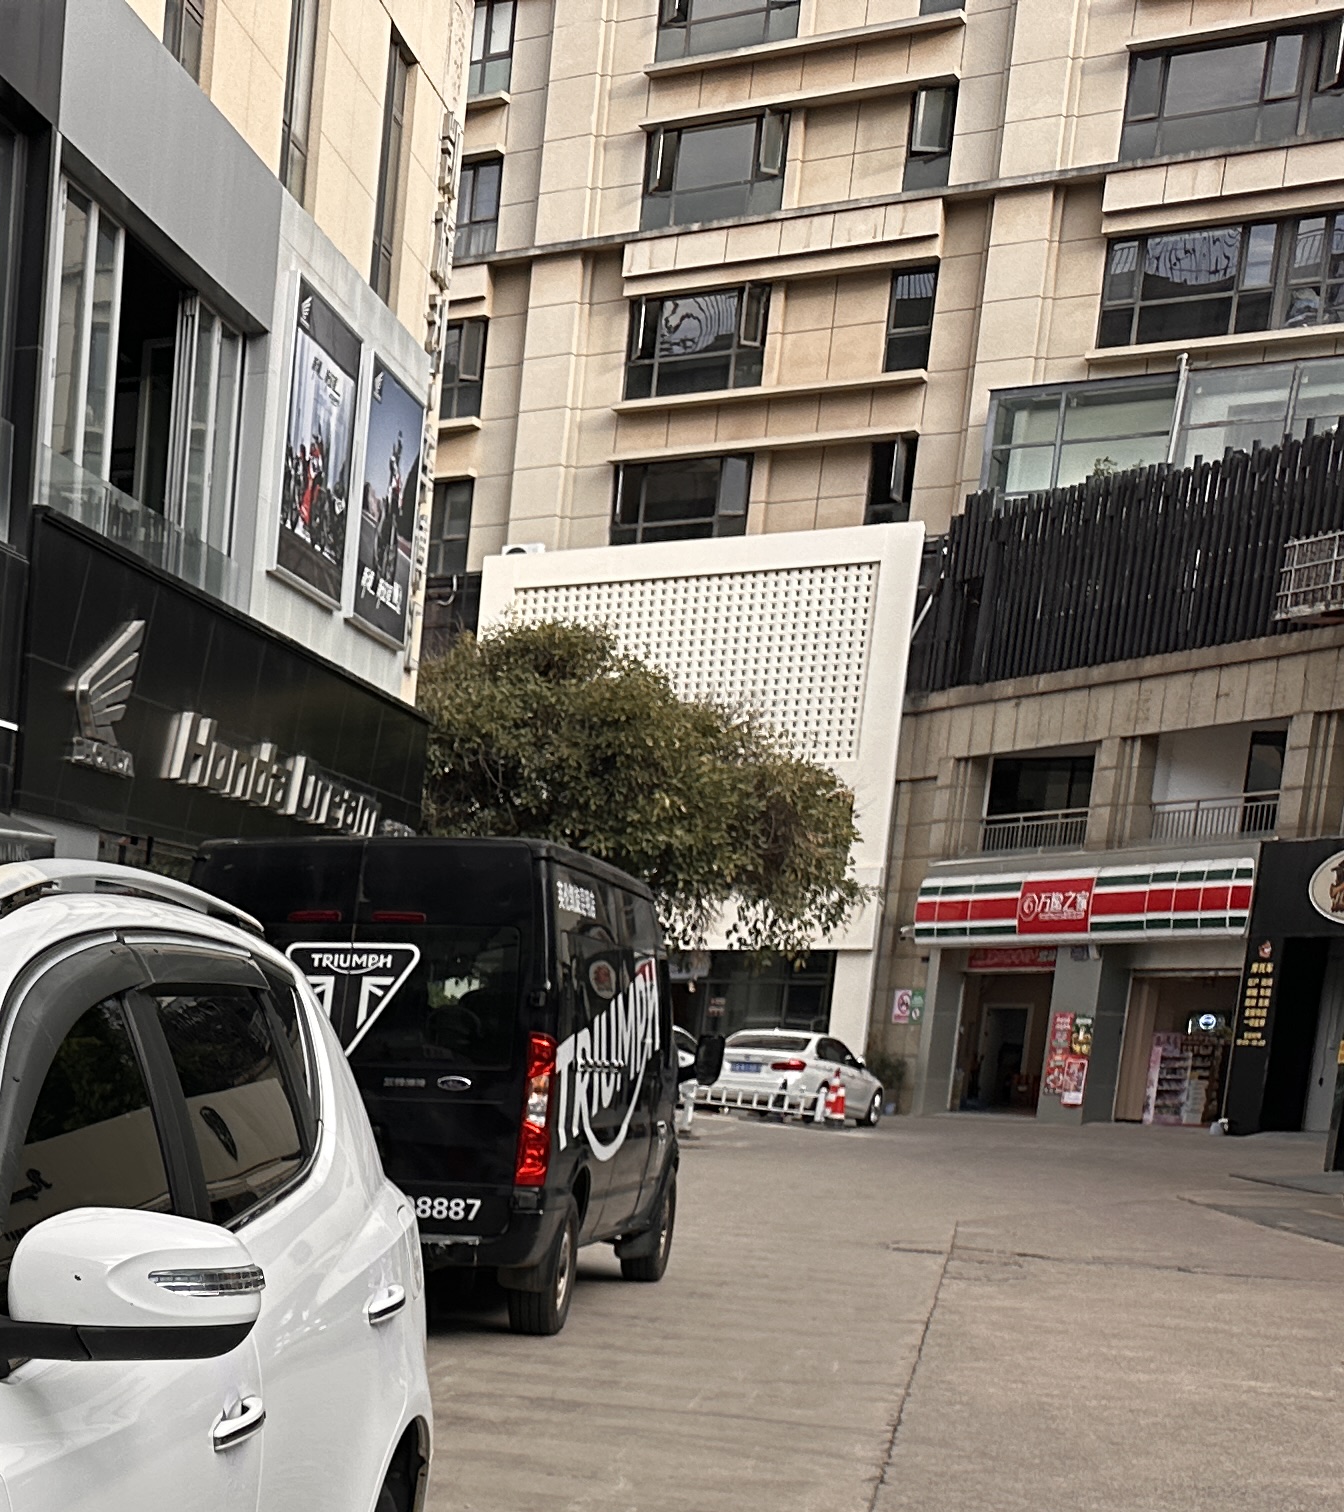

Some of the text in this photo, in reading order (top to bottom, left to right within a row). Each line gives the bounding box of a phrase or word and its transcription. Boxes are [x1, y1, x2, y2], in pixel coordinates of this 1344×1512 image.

[167, 711, 288, 815] Honda
[311, 952, 393, 975] TRIUMPH
[556, 957, 661, 1162] TRIUMPH
